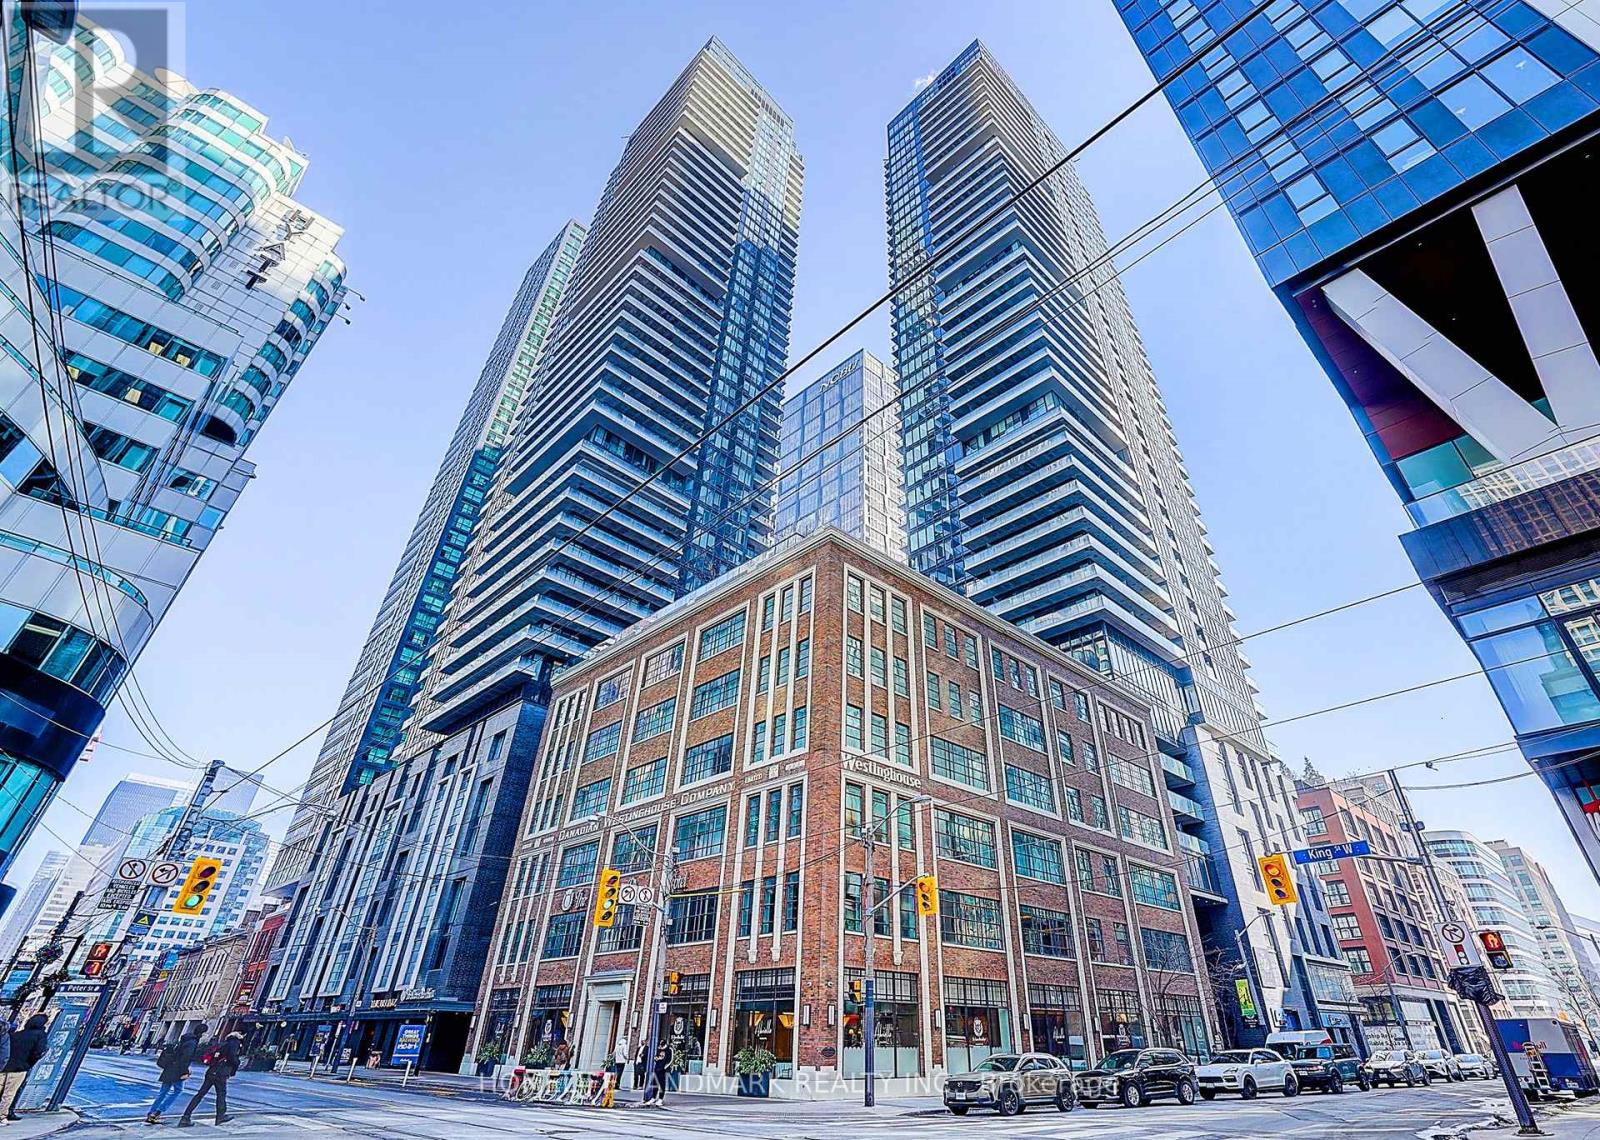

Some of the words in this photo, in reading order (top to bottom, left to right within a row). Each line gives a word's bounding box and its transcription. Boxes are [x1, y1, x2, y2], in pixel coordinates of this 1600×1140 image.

[245, 209, 315, 290] HYATT
[842, 753, 921, 789] Westinghouse
[604, 800, 677, 827] WESTINGHOUSE
[680, 782, 736, 807] COMPANY
[1307, 848, 1333, 860] King
[1342, 844, 1353, 855] W
[67, 984, 87, 992] Peter
